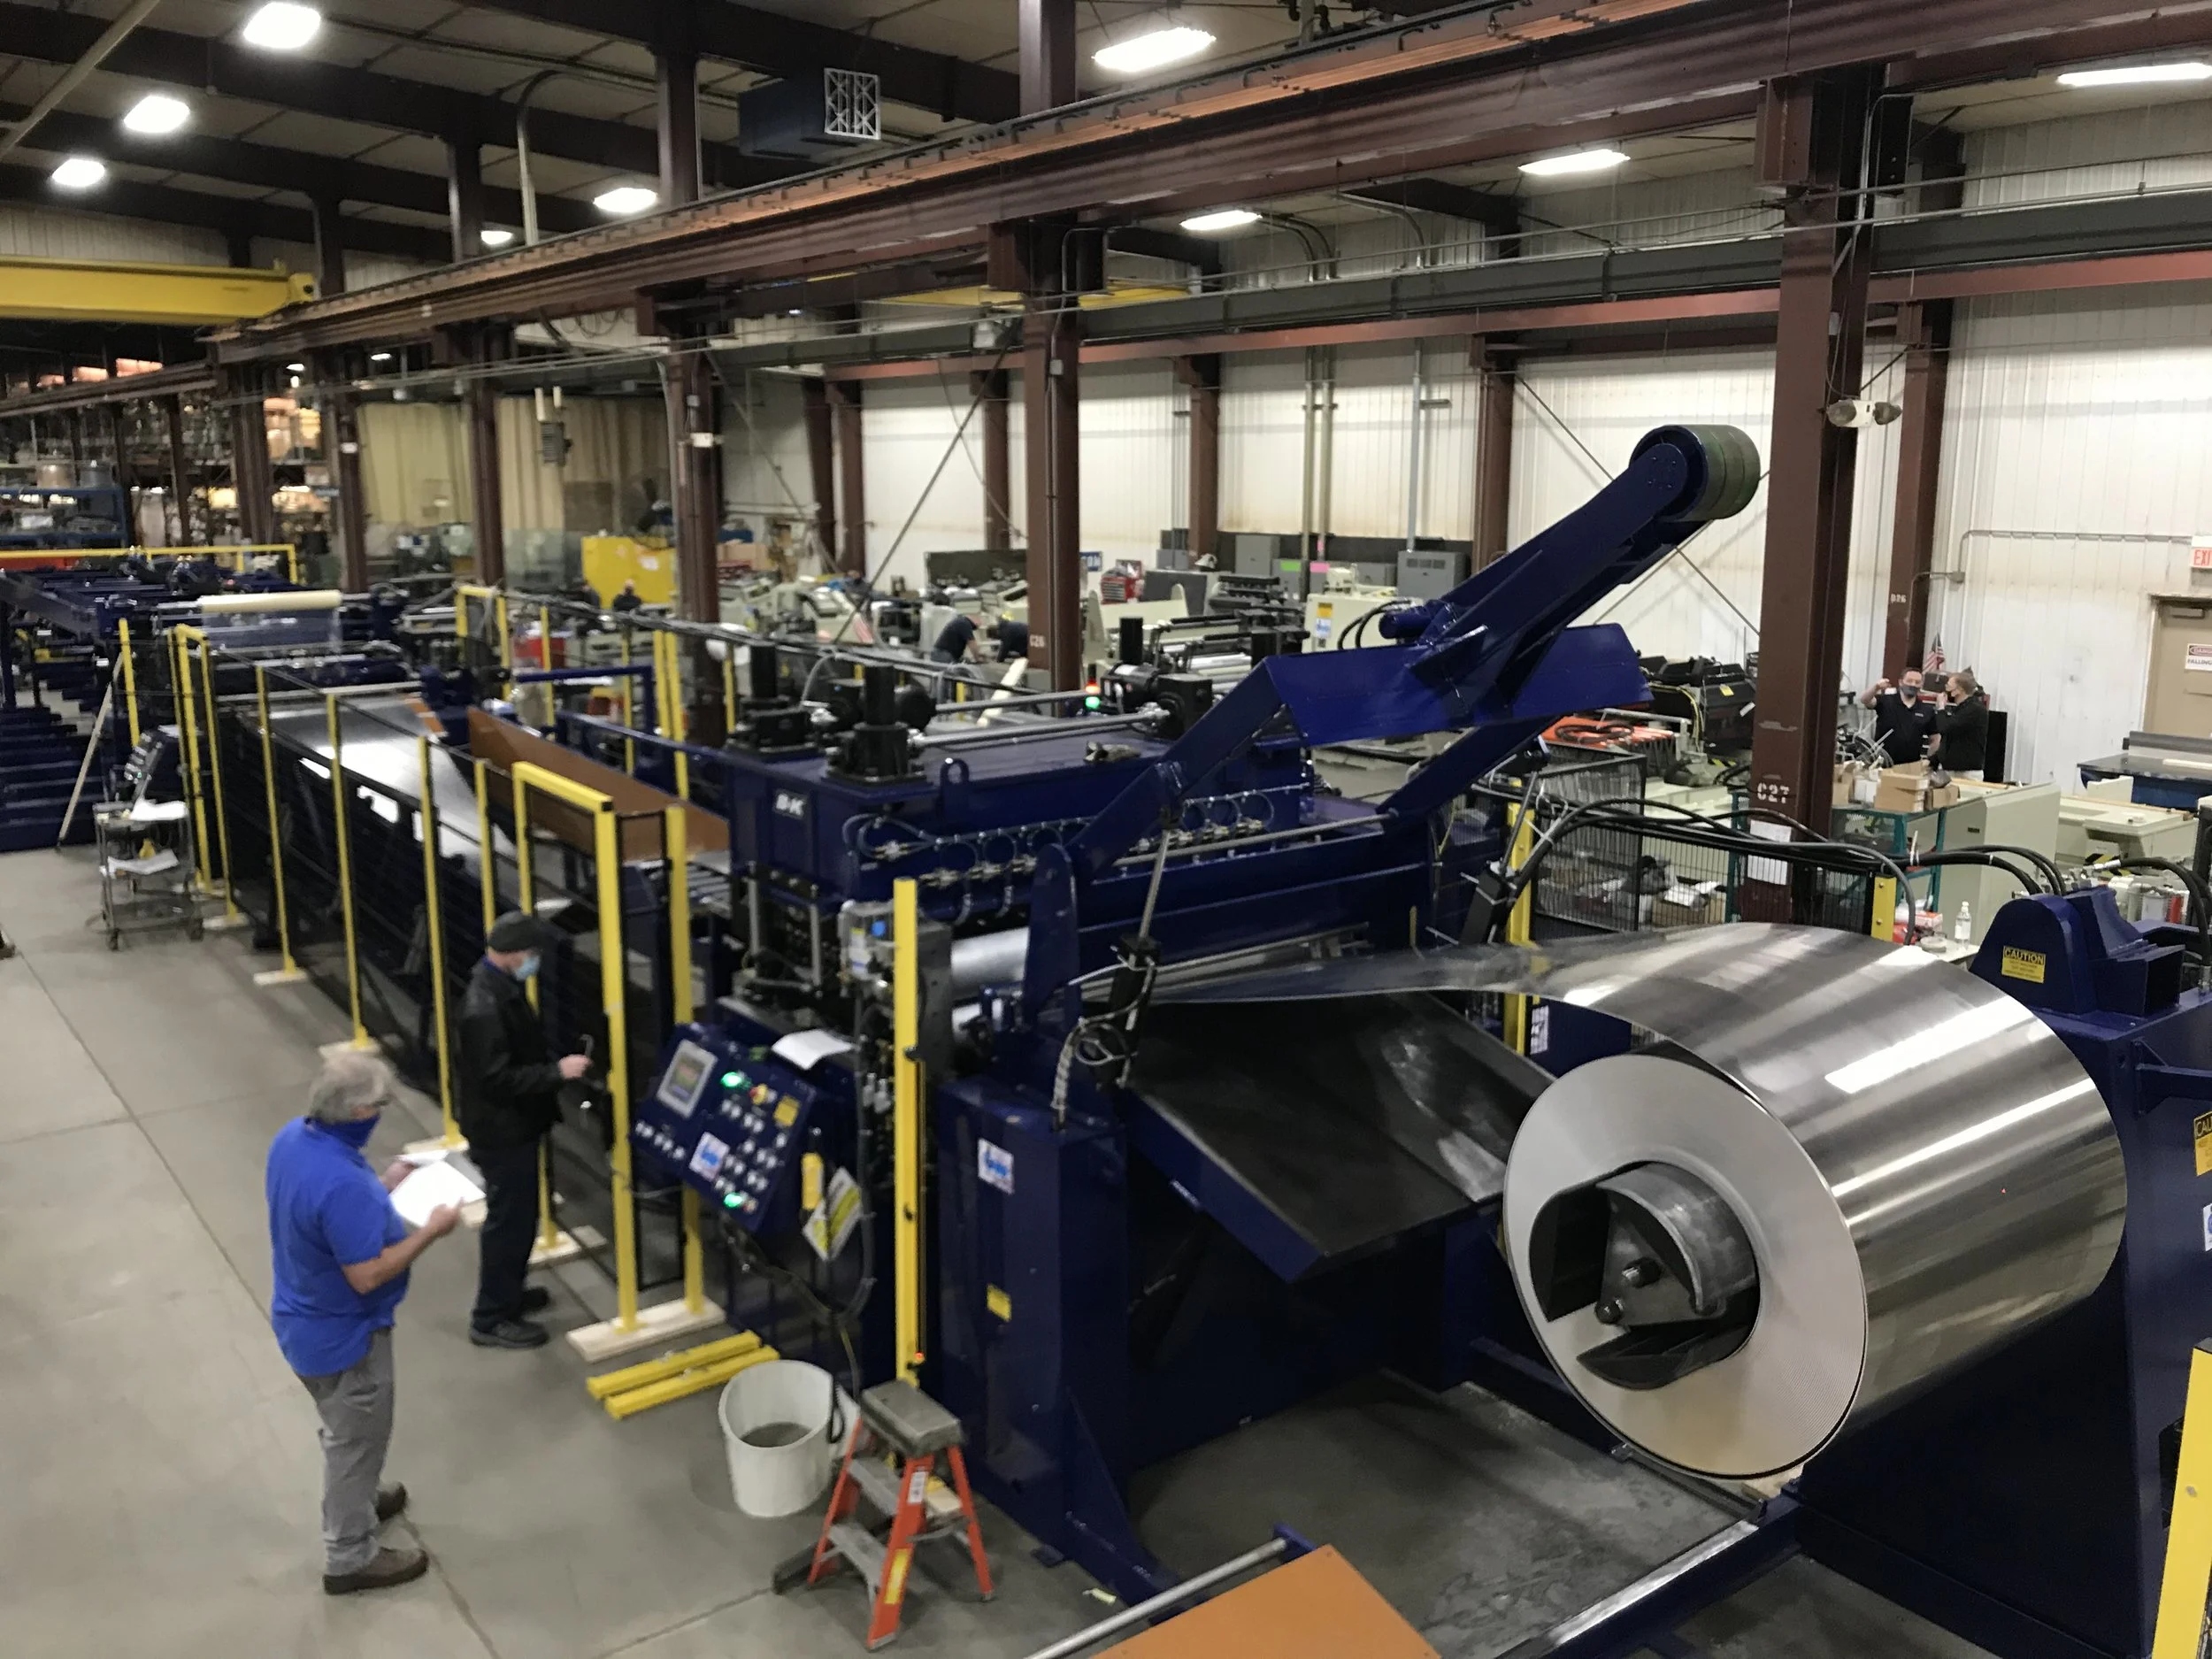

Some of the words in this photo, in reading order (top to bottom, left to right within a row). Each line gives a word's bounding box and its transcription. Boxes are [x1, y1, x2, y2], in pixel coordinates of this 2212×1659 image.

[2193, 549, 2212, 566] EXI
[1757, 782, 1790, 804] C27
[2004, 948, 2044, 965] CAUTION
